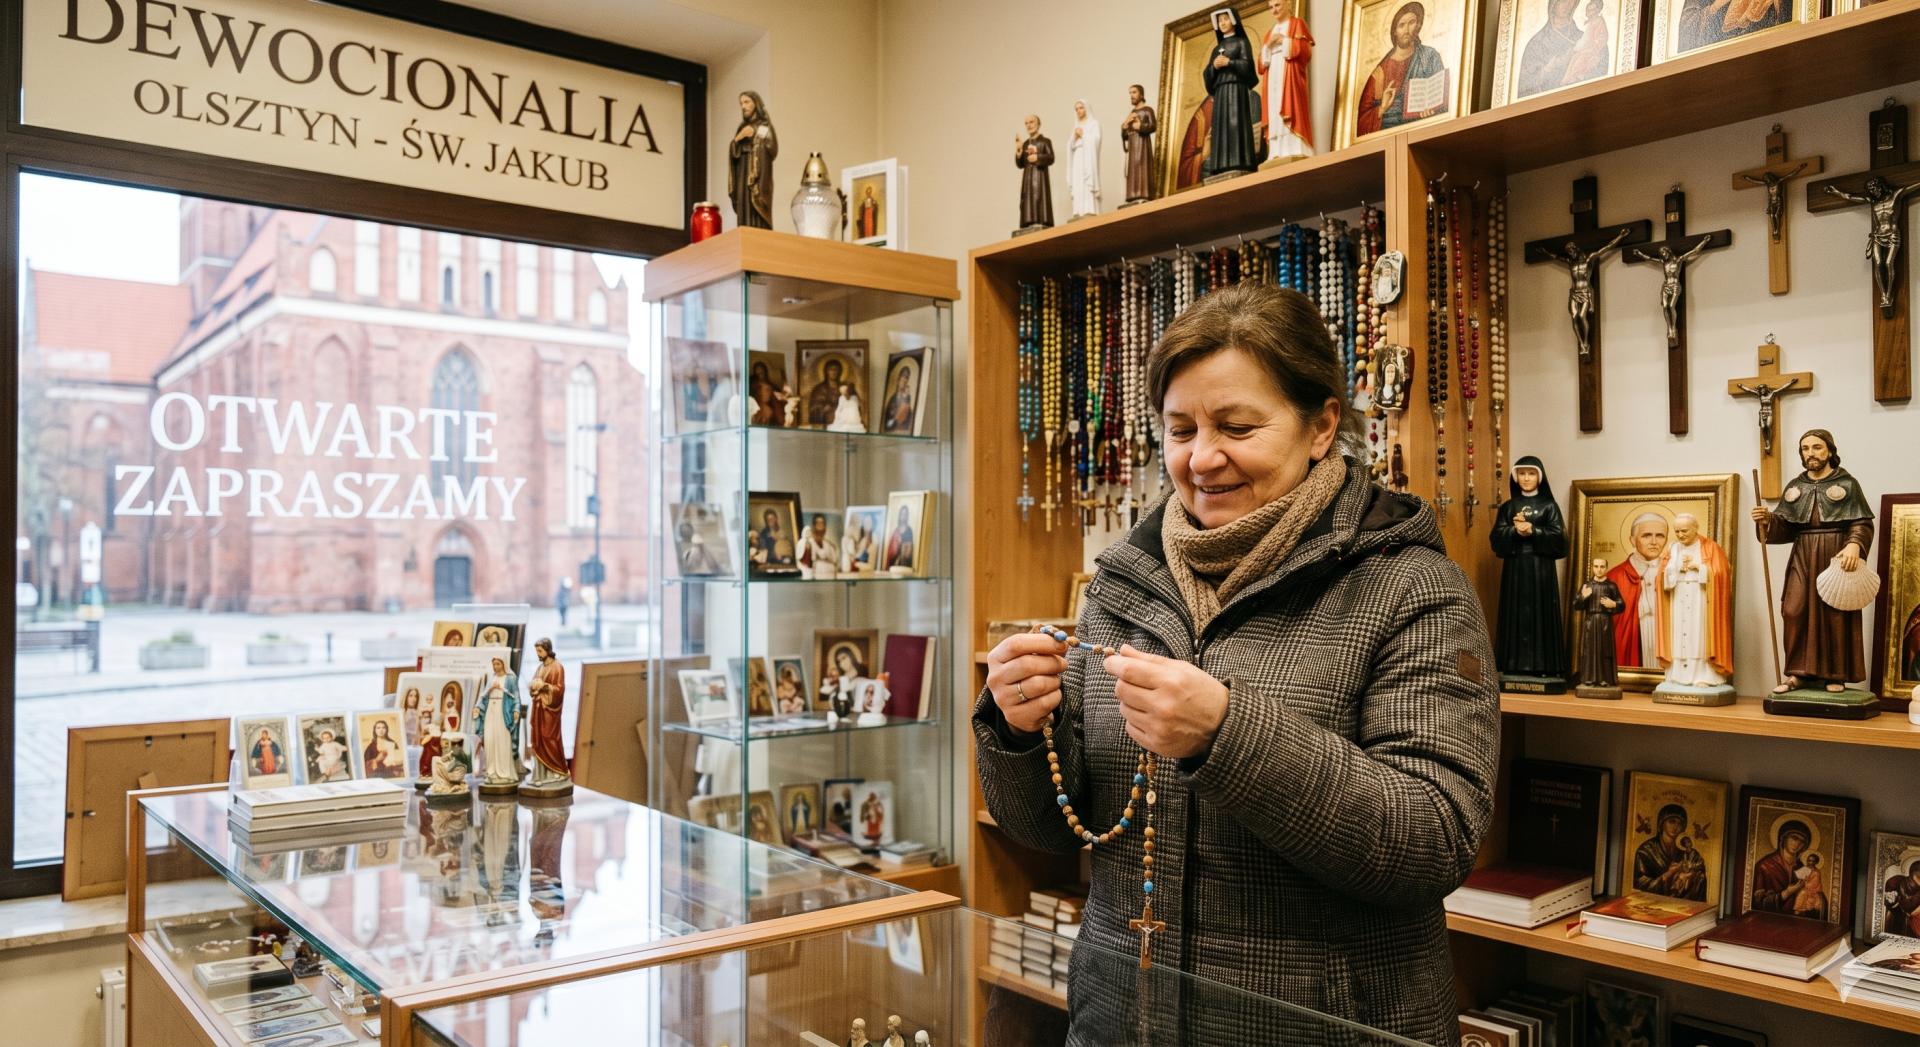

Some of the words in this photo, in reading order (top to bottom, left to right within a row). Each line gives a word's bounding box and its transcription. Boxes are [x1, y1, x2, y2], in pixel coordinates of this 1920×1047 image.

[58, 0, 663, 155] DEWOCIONALIA
[133, 79, 359, 148] OLSZTYN
[403, 119, 470, 168] ŚW.
[484, 143, 609, 191] JAKUB
[150, 391, 498, 463] OTWARTE
[113, 465, 527, 521] ZAPRASZAMY
